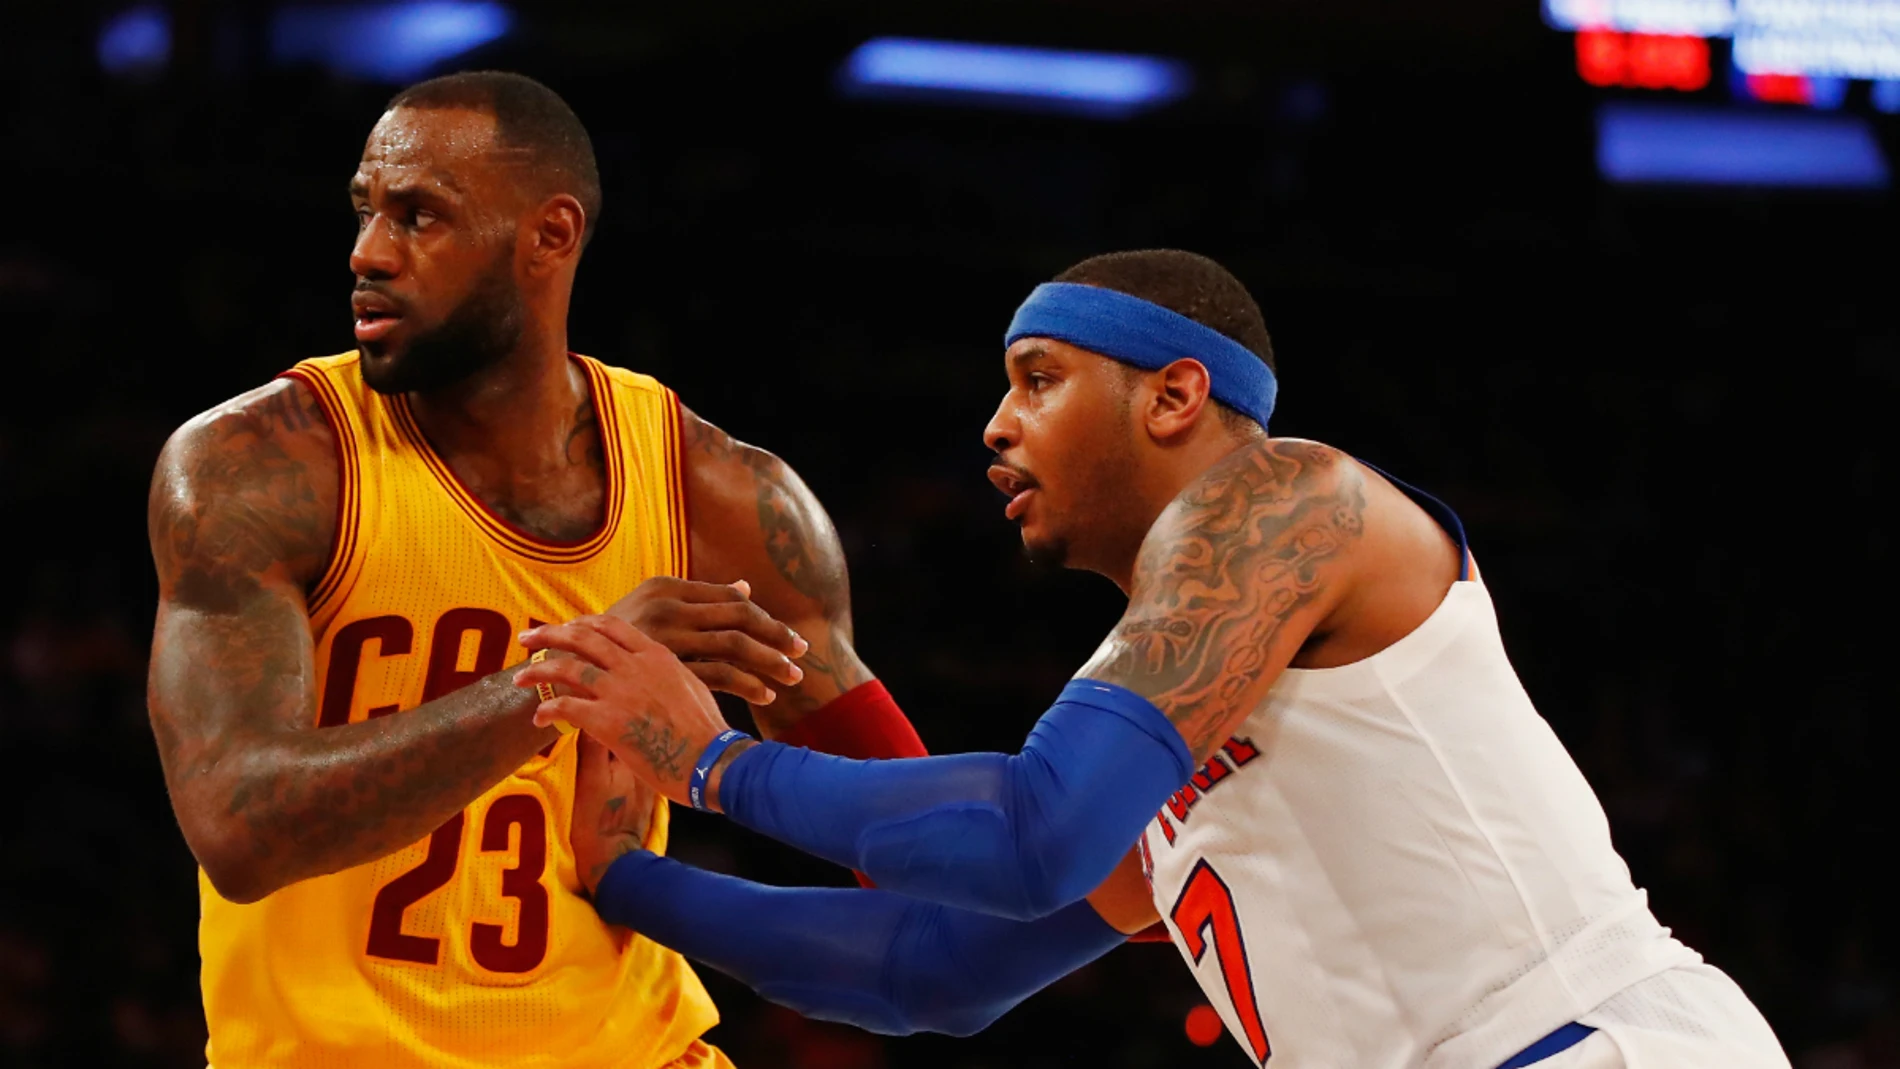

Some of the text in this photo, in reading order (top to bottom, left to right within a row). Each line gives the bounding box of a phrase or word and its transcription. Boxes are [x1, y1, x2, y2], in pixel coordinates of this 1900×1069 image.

[317, 607, 550, 730] CA
[366, 793, 549, 974] 23
[1170, 856, 1271, 1069] 7
